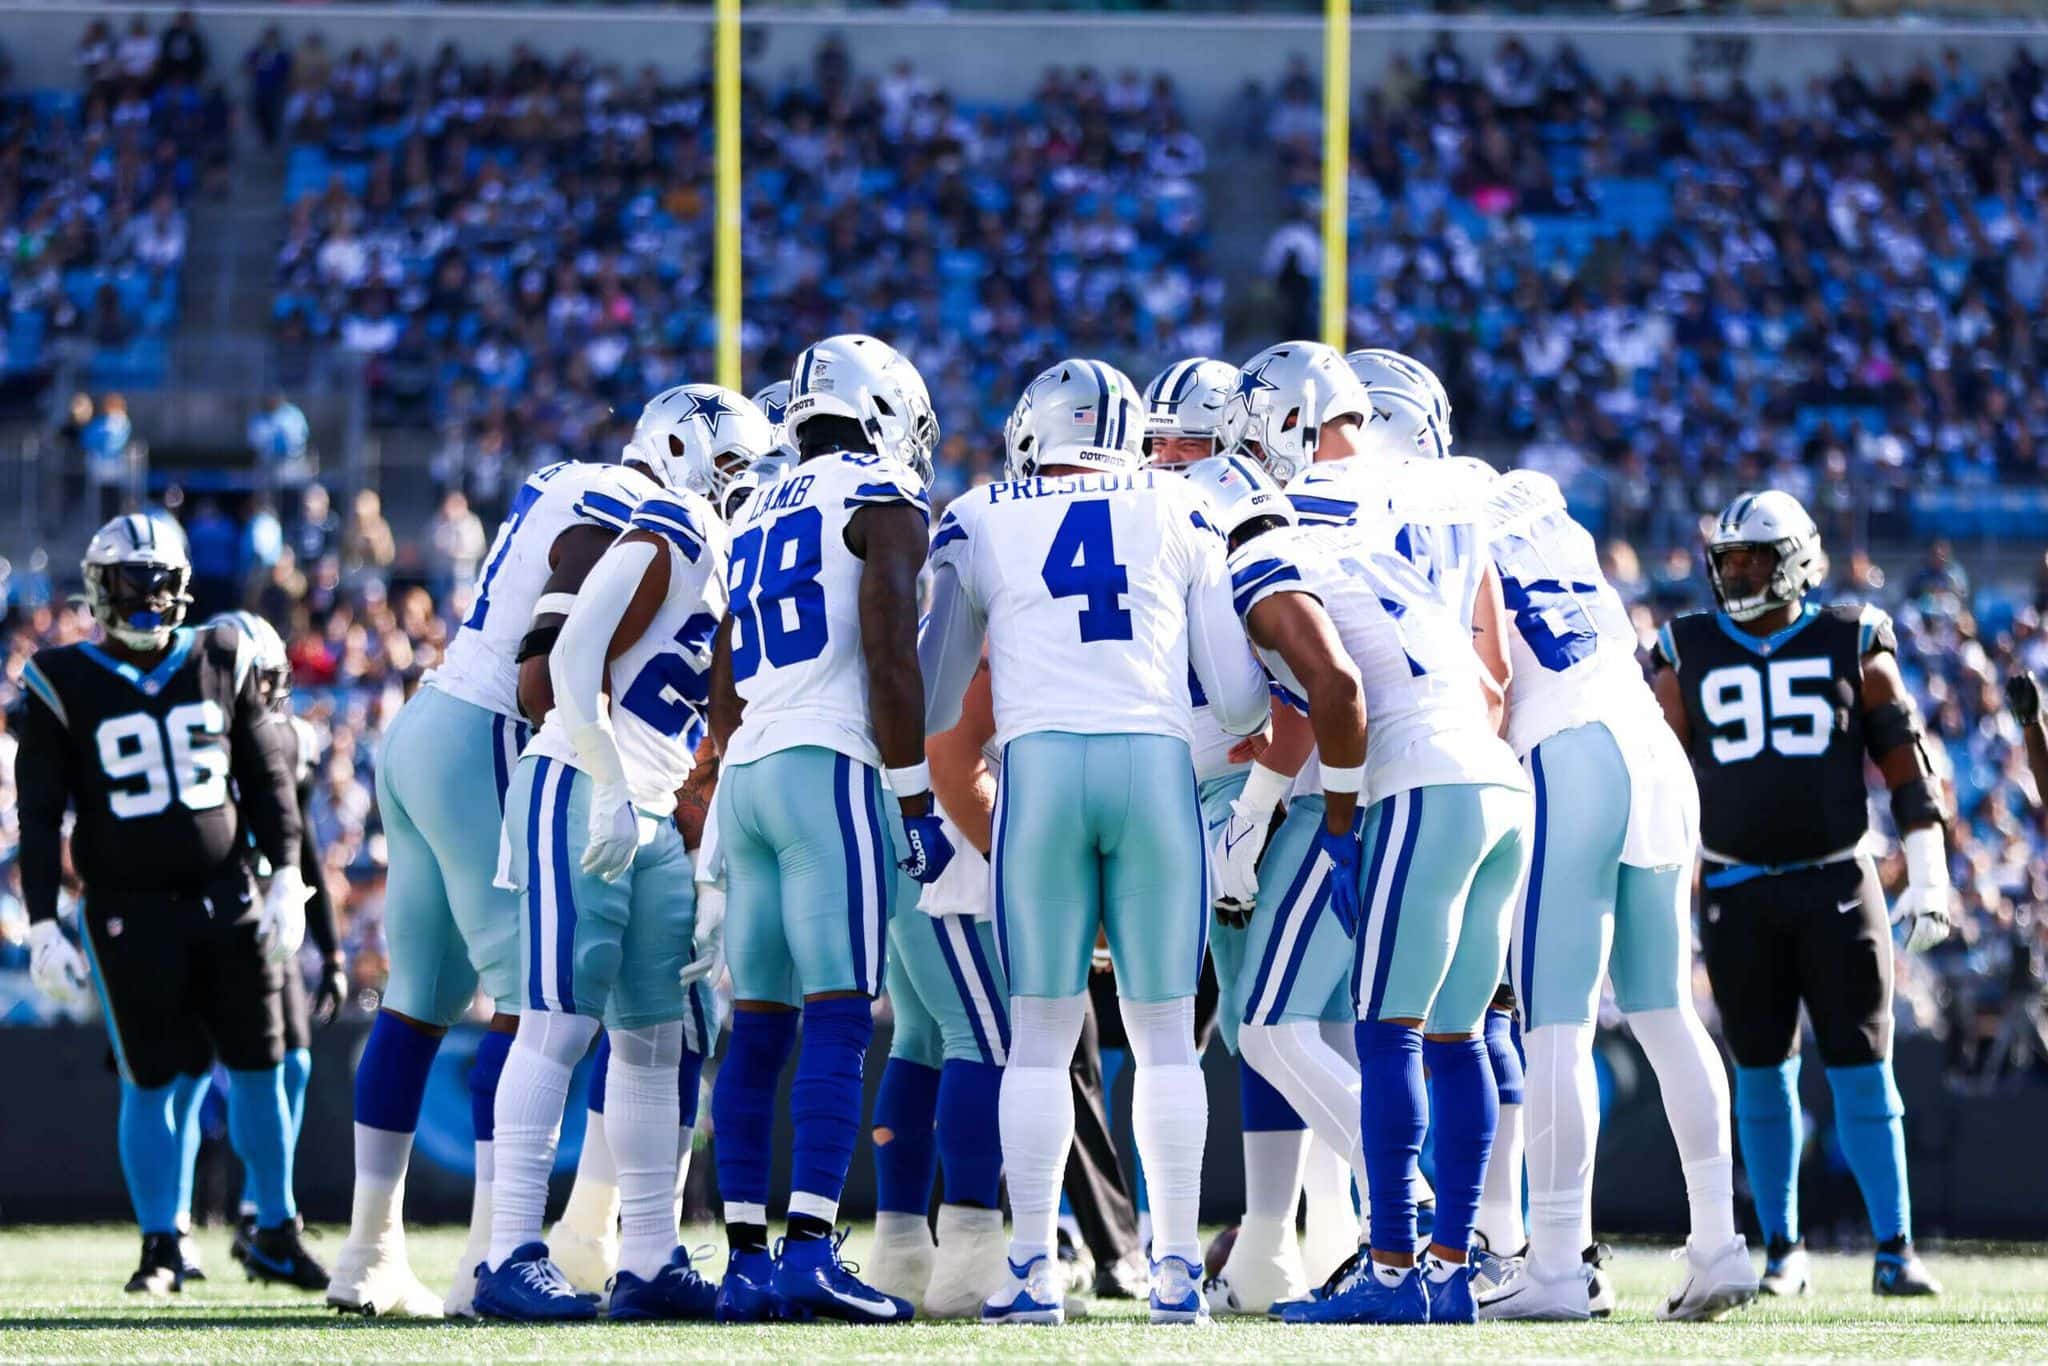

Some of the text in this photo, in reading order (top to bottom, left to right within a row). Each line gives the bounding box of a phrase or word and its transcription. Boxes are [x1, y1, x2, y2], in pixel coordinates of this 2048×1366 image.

[748, 475, 816, 523] LAMB
[988, 471, 1154, 504] PRESCOTT
[727, 506, 829, 684] 88
[1041, 499, 1134, 644] 4
[96, 699, 228, 818] 96
[1701, 656, 1835, 765] 95
